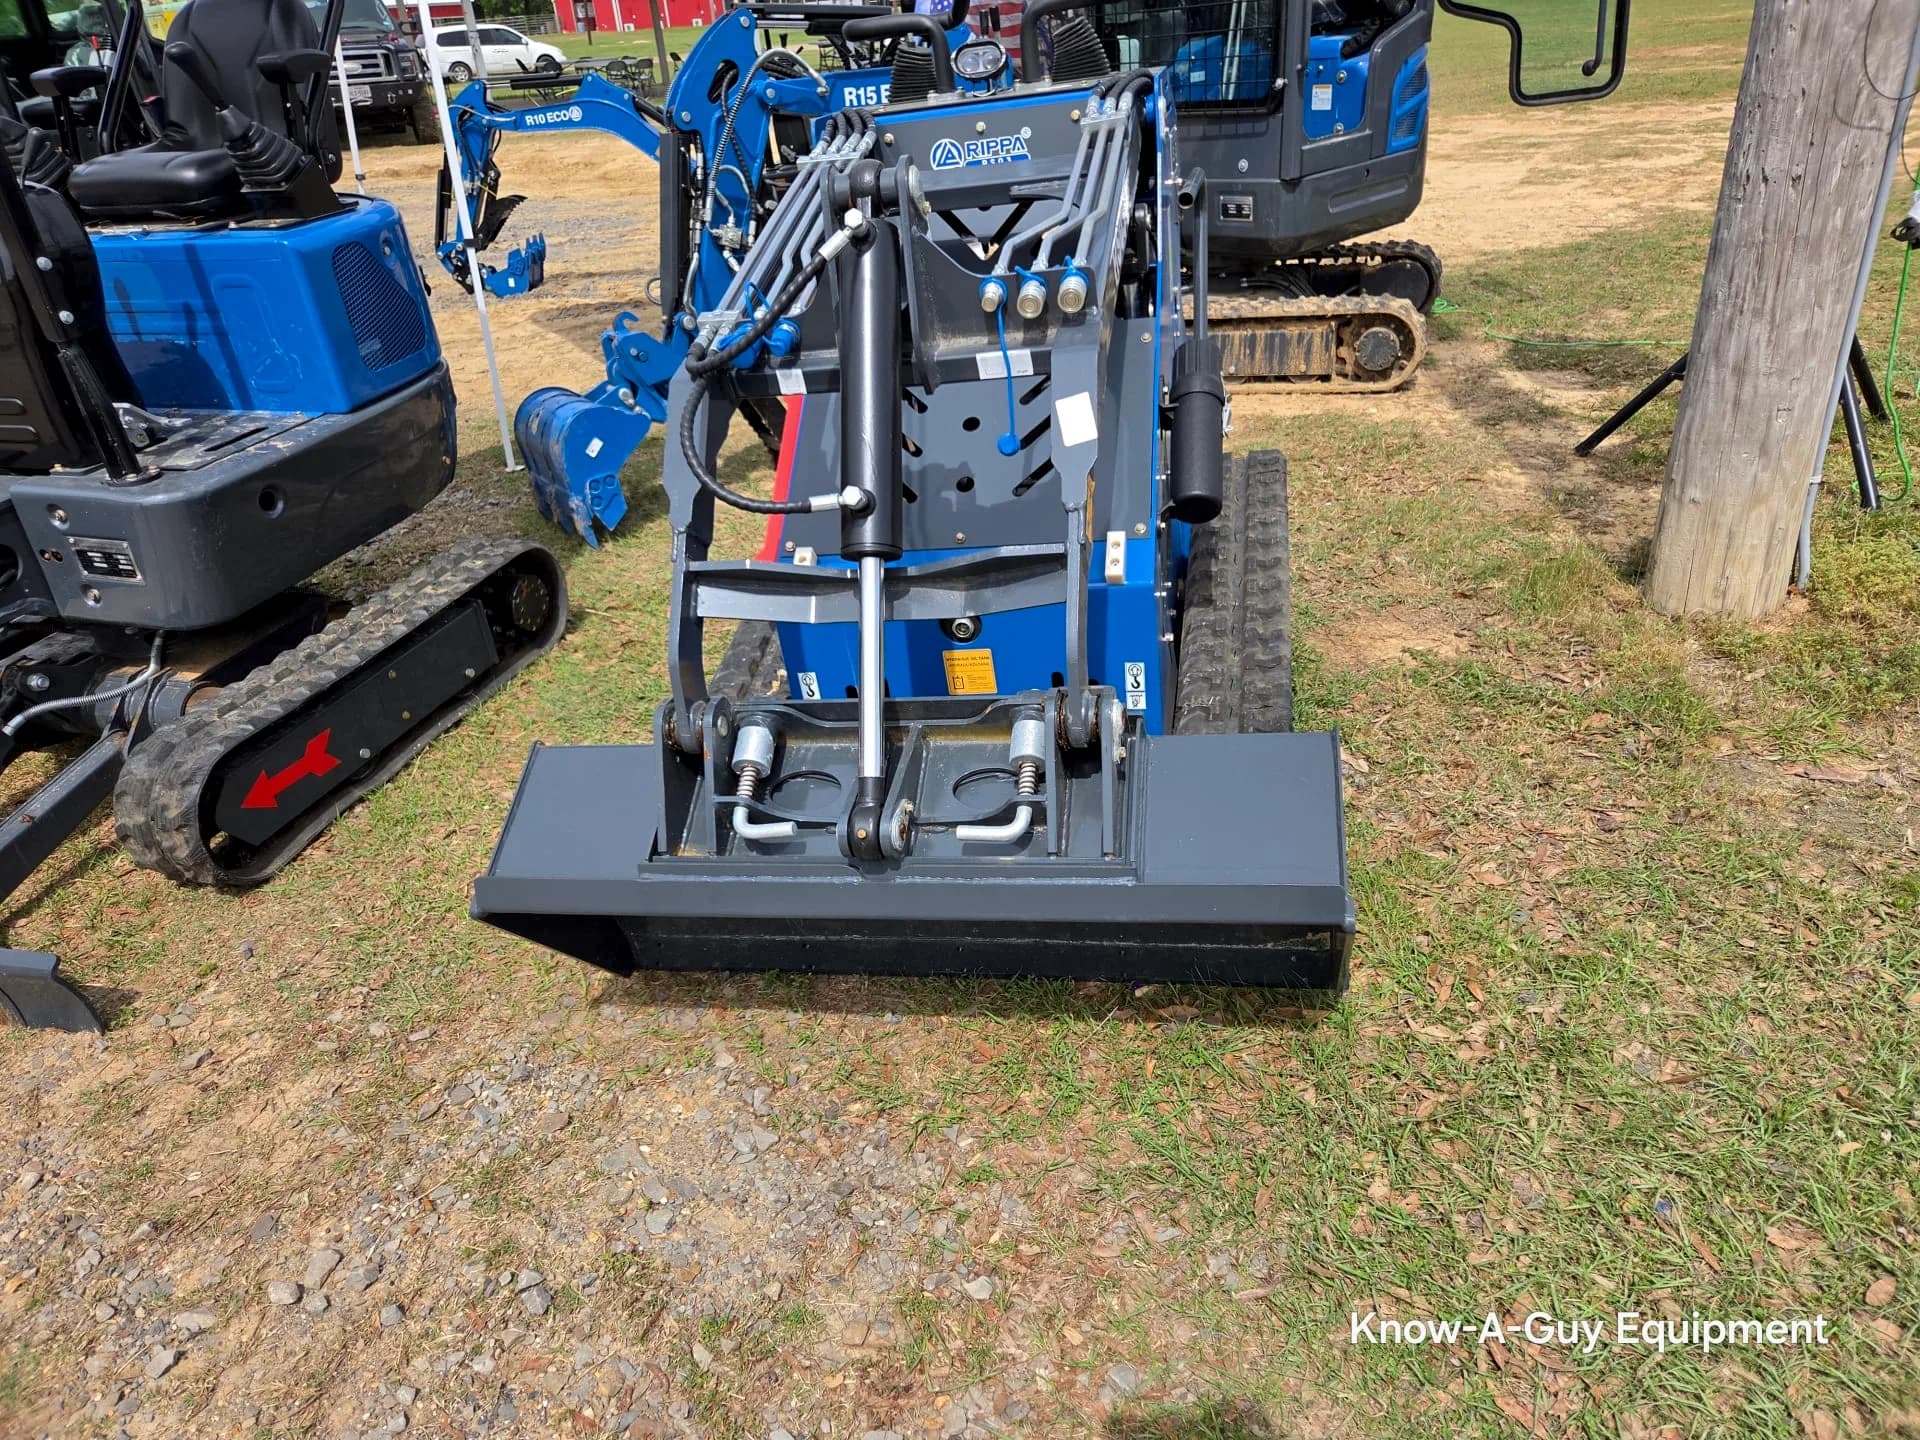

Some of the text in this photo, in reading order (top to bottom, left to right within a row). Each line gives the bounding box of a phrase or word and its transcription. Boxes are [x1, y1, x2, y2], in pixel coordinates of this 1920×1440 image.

[843, 86, 878, 107] R15
[525, 109, 570, 126] R10 ECO
[964, 135, 1028, 159] RIPPA
